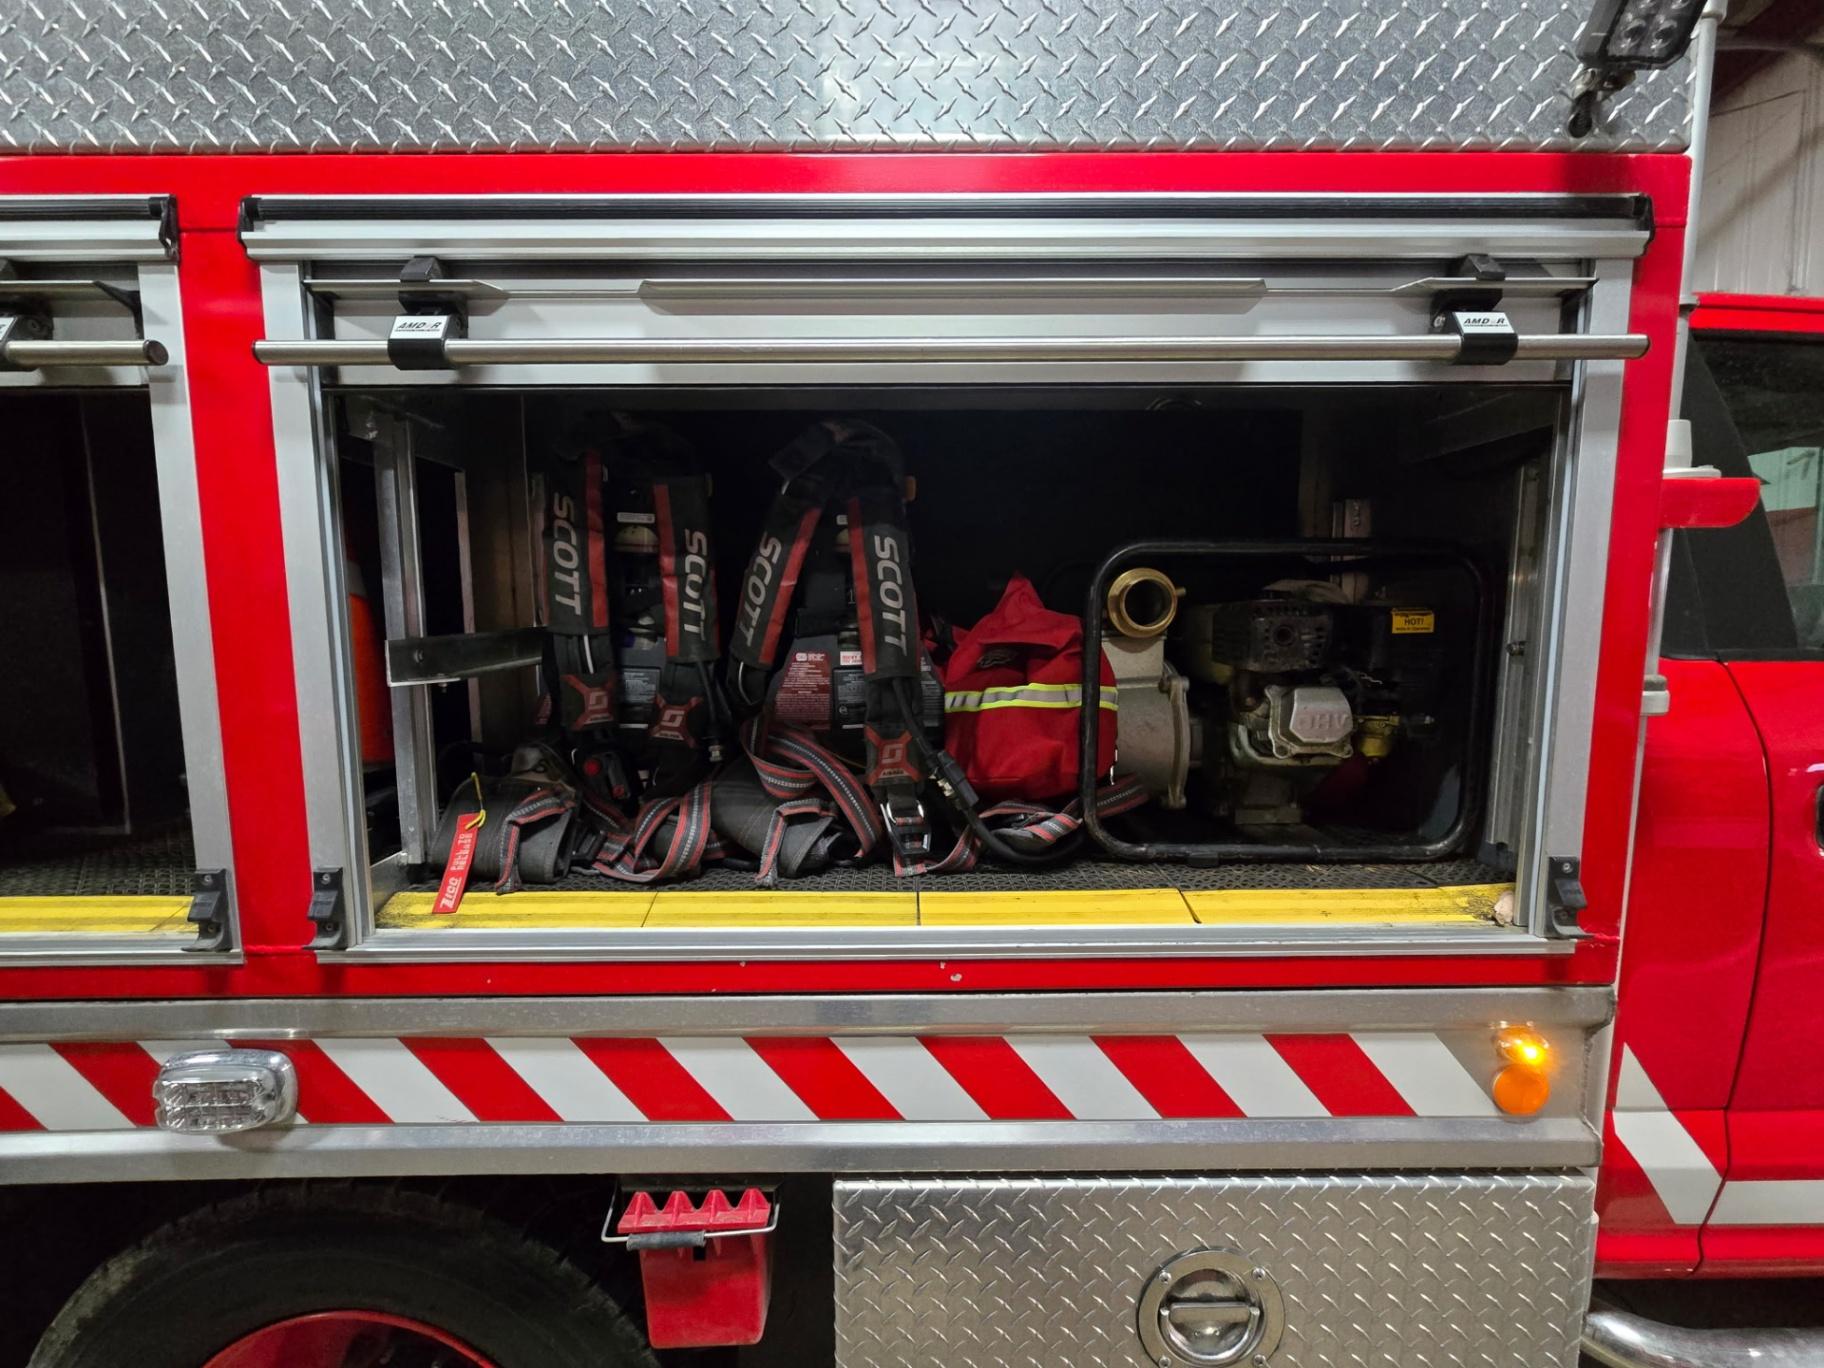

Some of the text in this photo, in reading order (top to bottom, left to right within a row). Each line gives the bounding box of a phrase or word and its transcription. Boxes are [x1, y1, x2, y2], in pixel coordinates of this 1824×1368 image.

[398, 321, 442, 329] AMDR
[553, 492, 582, 617] SCOTT
[683, 528, 708, 641] SCOTT
[742, 531, 782, 647] SCOTT
[874, 535, 907, 657] SCOTT
[440, 877, 460, 908] ZICO
